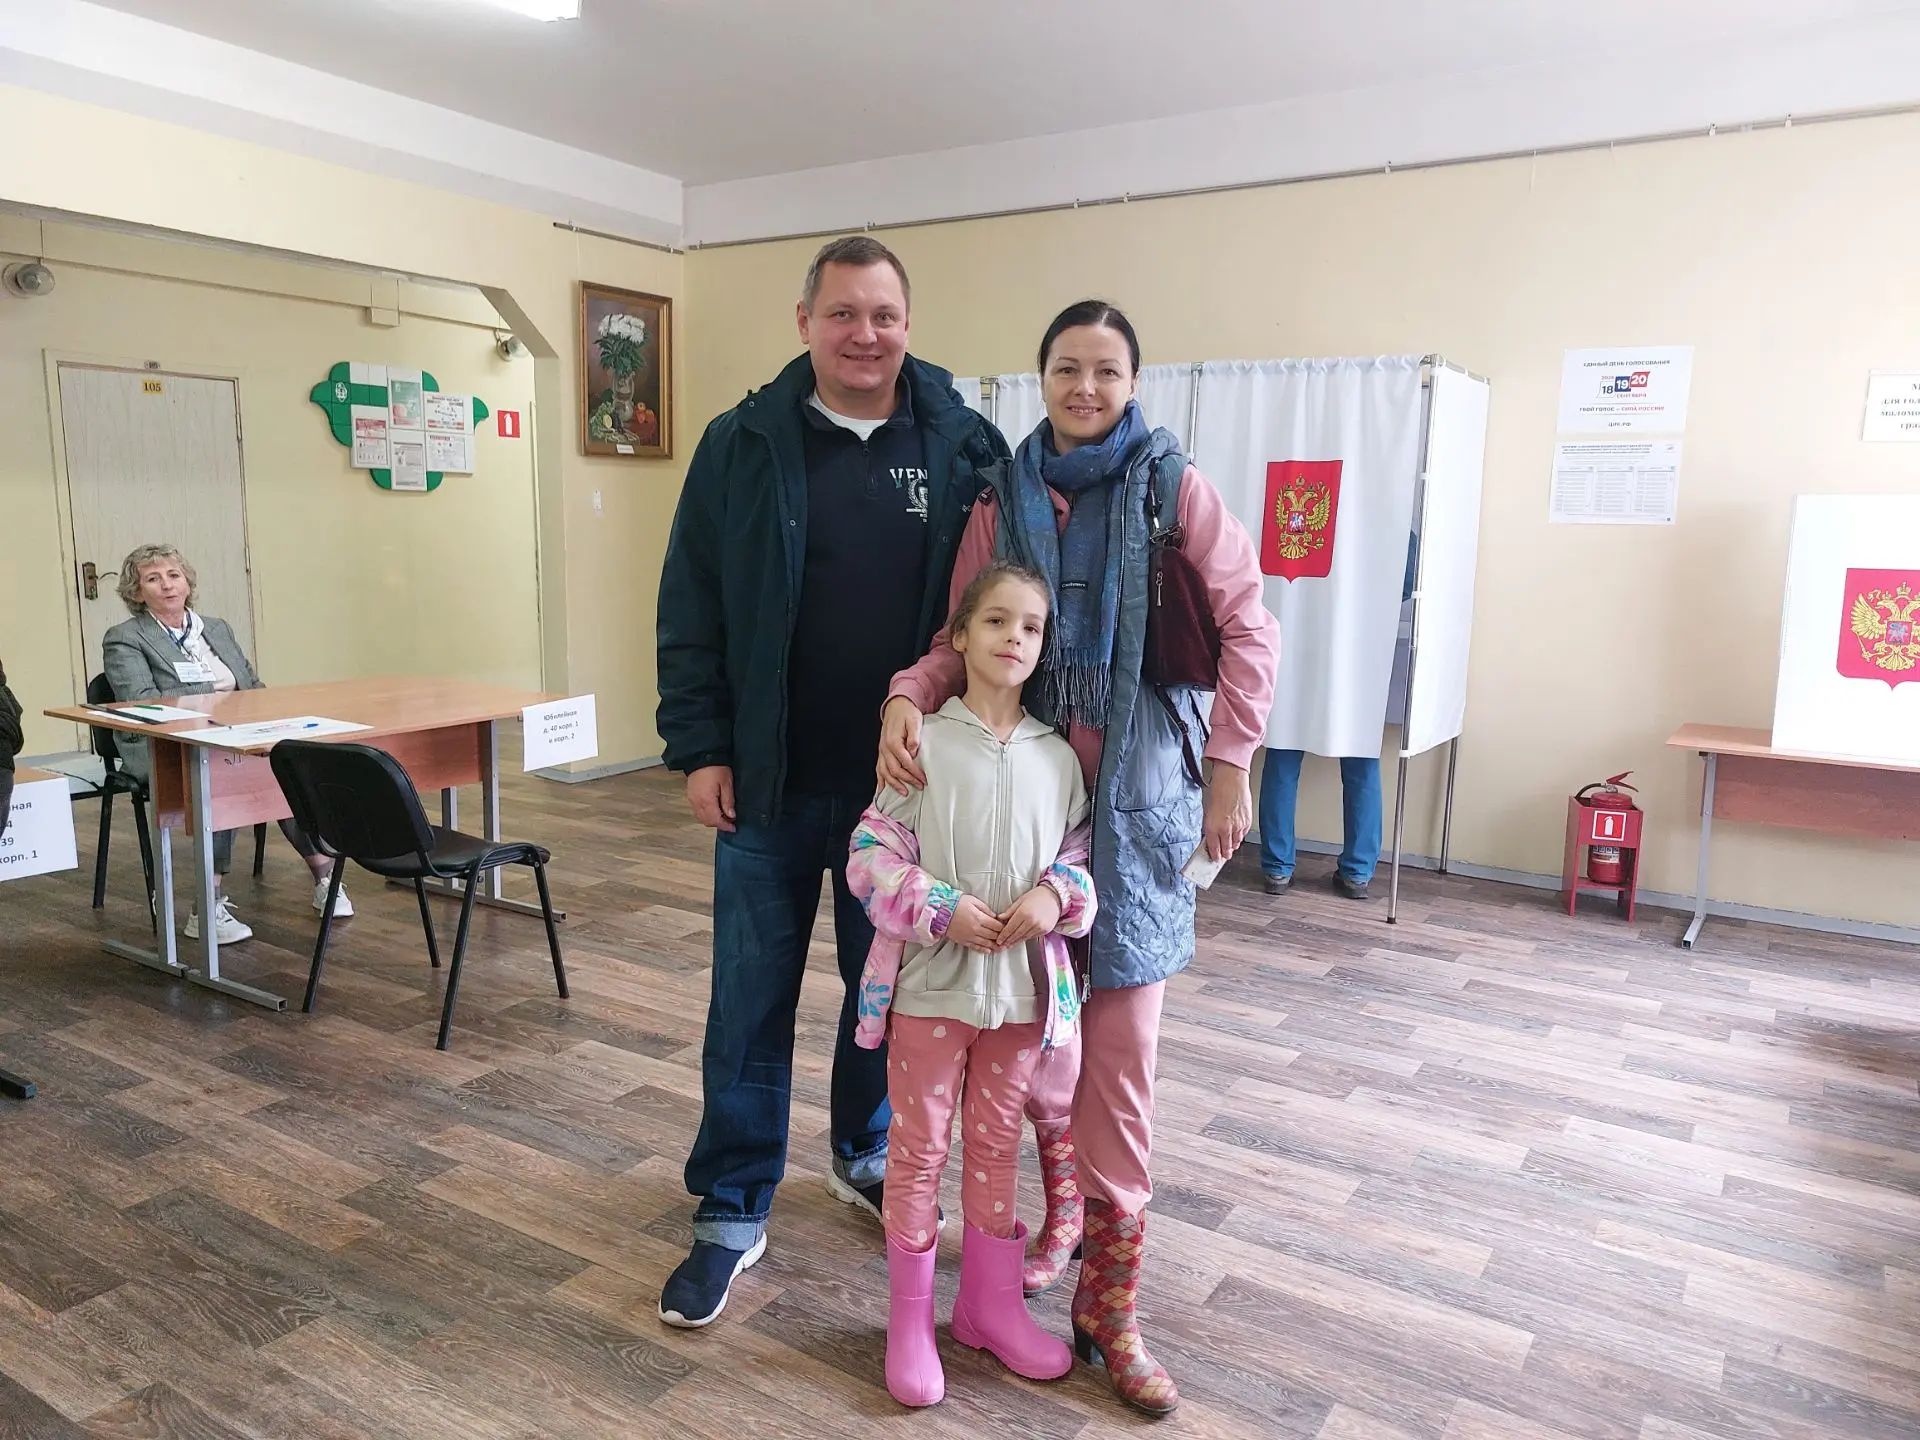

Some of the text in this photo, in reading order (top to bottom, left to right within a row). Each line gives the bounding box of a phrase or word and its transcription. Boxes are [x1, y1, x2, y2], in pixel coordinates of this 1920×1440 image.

[1631, 374, 1646, 384] 20
[144, 382, 161, 391] 105
[1616, 379, 1629, 390] 19
[1602, 385, 1614, 394] 18
[544, 711, 577, 720] Юбилейная
[10, 801, 32, 811] ная
[31, 850, 38, 859] 1
